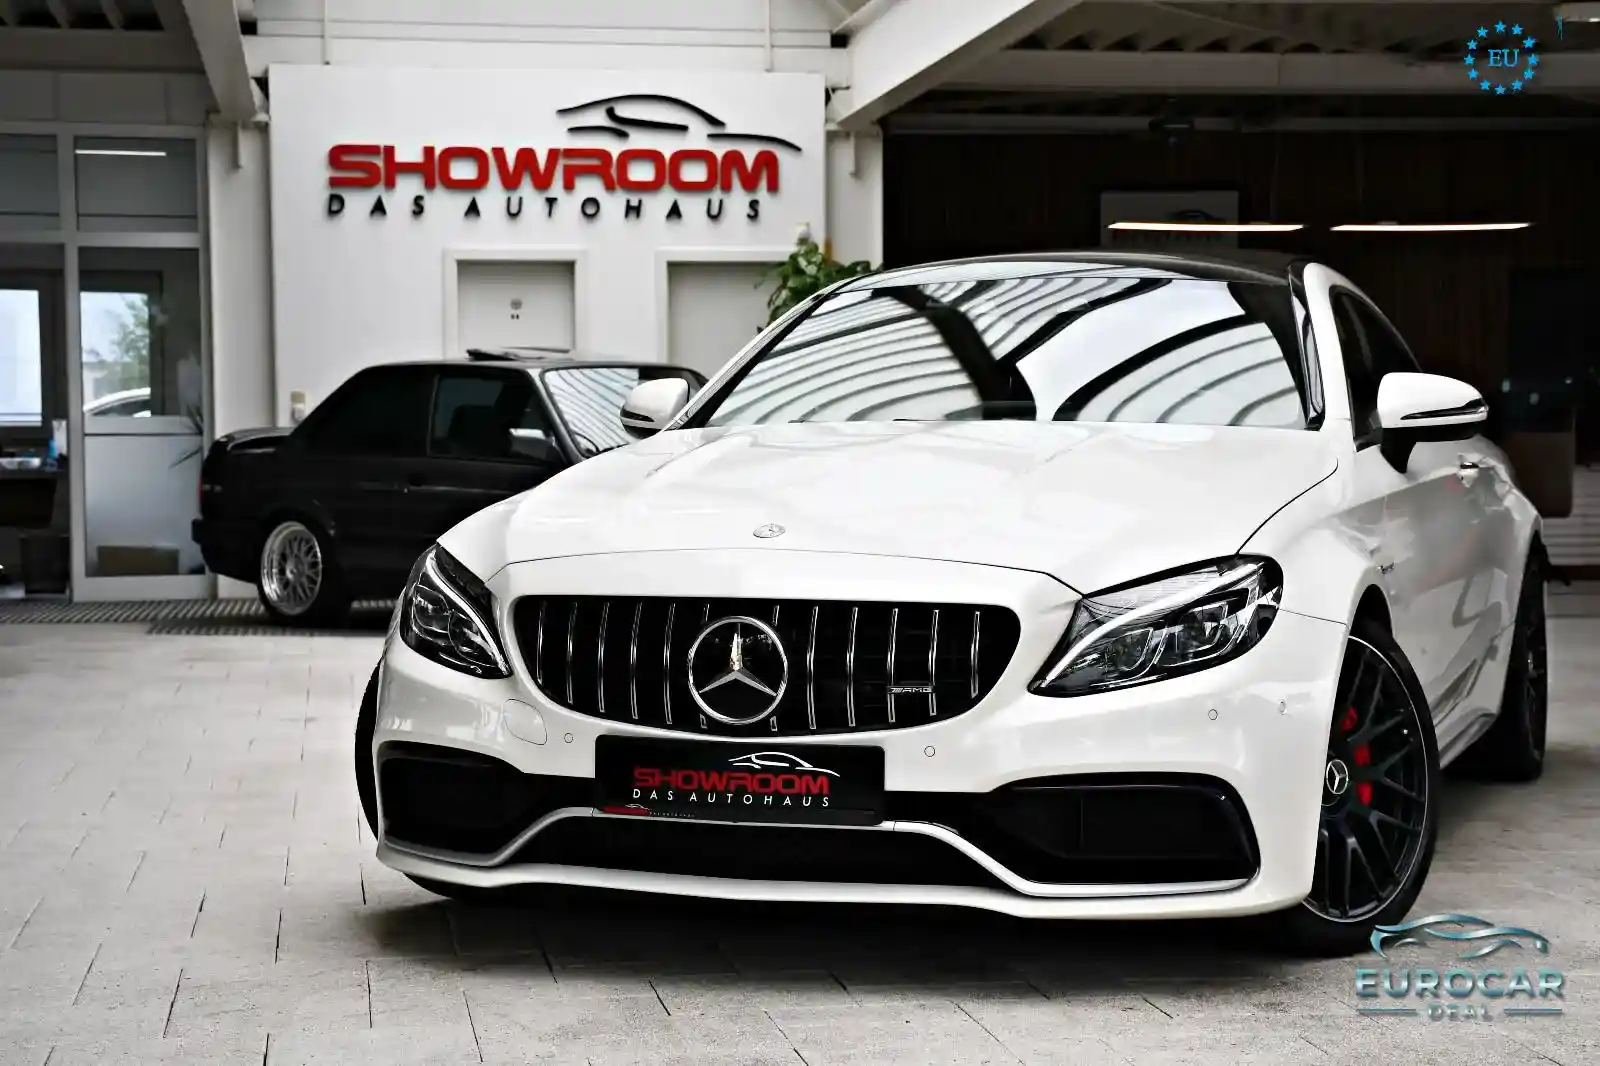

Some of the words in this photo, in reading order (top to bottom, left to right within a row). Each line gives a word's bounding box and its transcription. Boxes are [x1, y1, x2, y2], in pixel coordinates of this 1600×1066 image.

[327, 144, 781, 194] SHOWROOM
[327, 194, 426, 218] DAS
[463, 196, 761, 220] AUTOHAUS
[632, 767, 830, 795] SHOWROOM
[632, 788, 674, 801] DAS
[690, 792, 829, 807] AUTOHAUS
